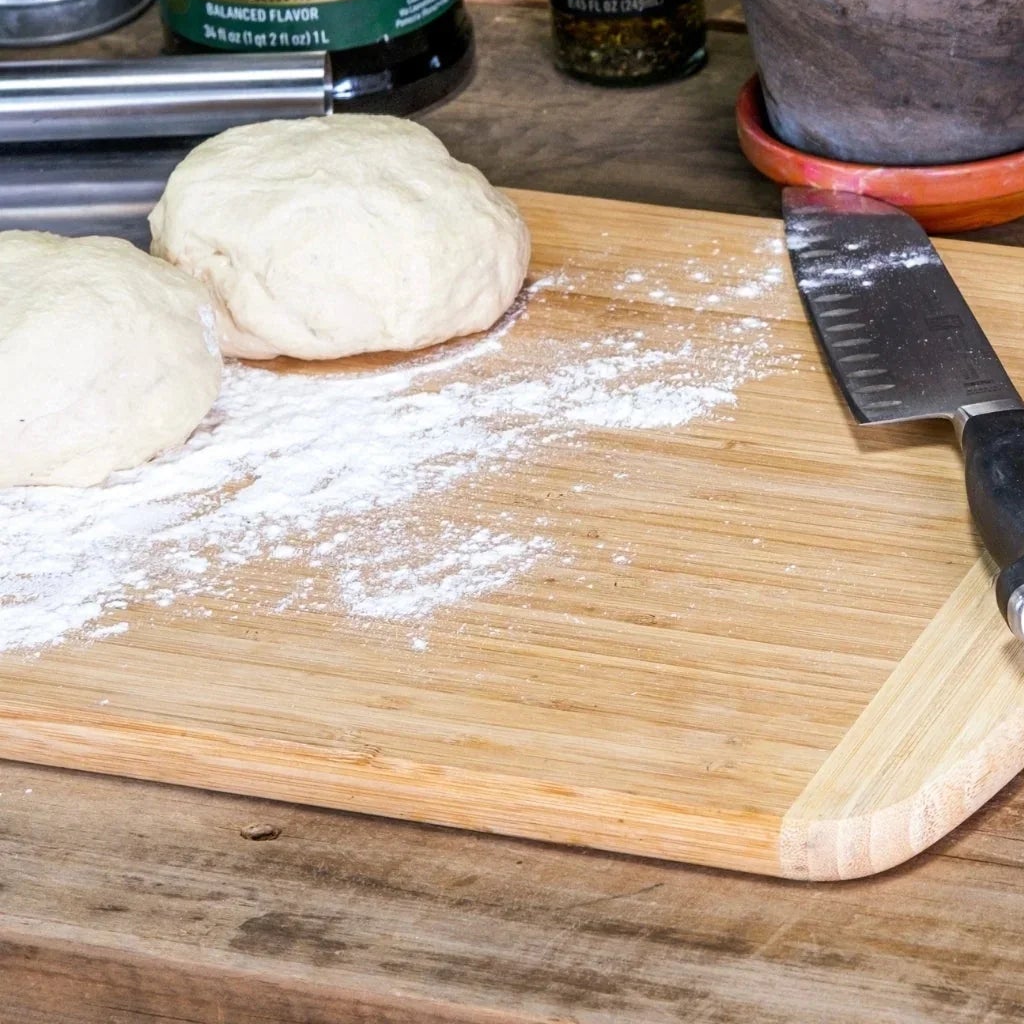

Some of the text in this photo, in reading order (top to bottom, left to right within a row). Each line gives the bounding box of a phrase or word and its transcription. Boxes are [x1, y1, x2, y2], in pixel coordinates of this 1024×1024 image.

[205, 2, 319, 22] BALANCED FLAVOR
[203, 24, 217, 39] 34
[218, 27, 227, 41] fl
[228, 30, 241, 43] oz
[243, 30, 251, 45] (1
[254, 32, 267, 48] qt
[270, 31, 277, 45] 2
[279, 30, 289, 45] fl
[291, 30, 311, 45] oz)
[321, 30, 330, 44] L
